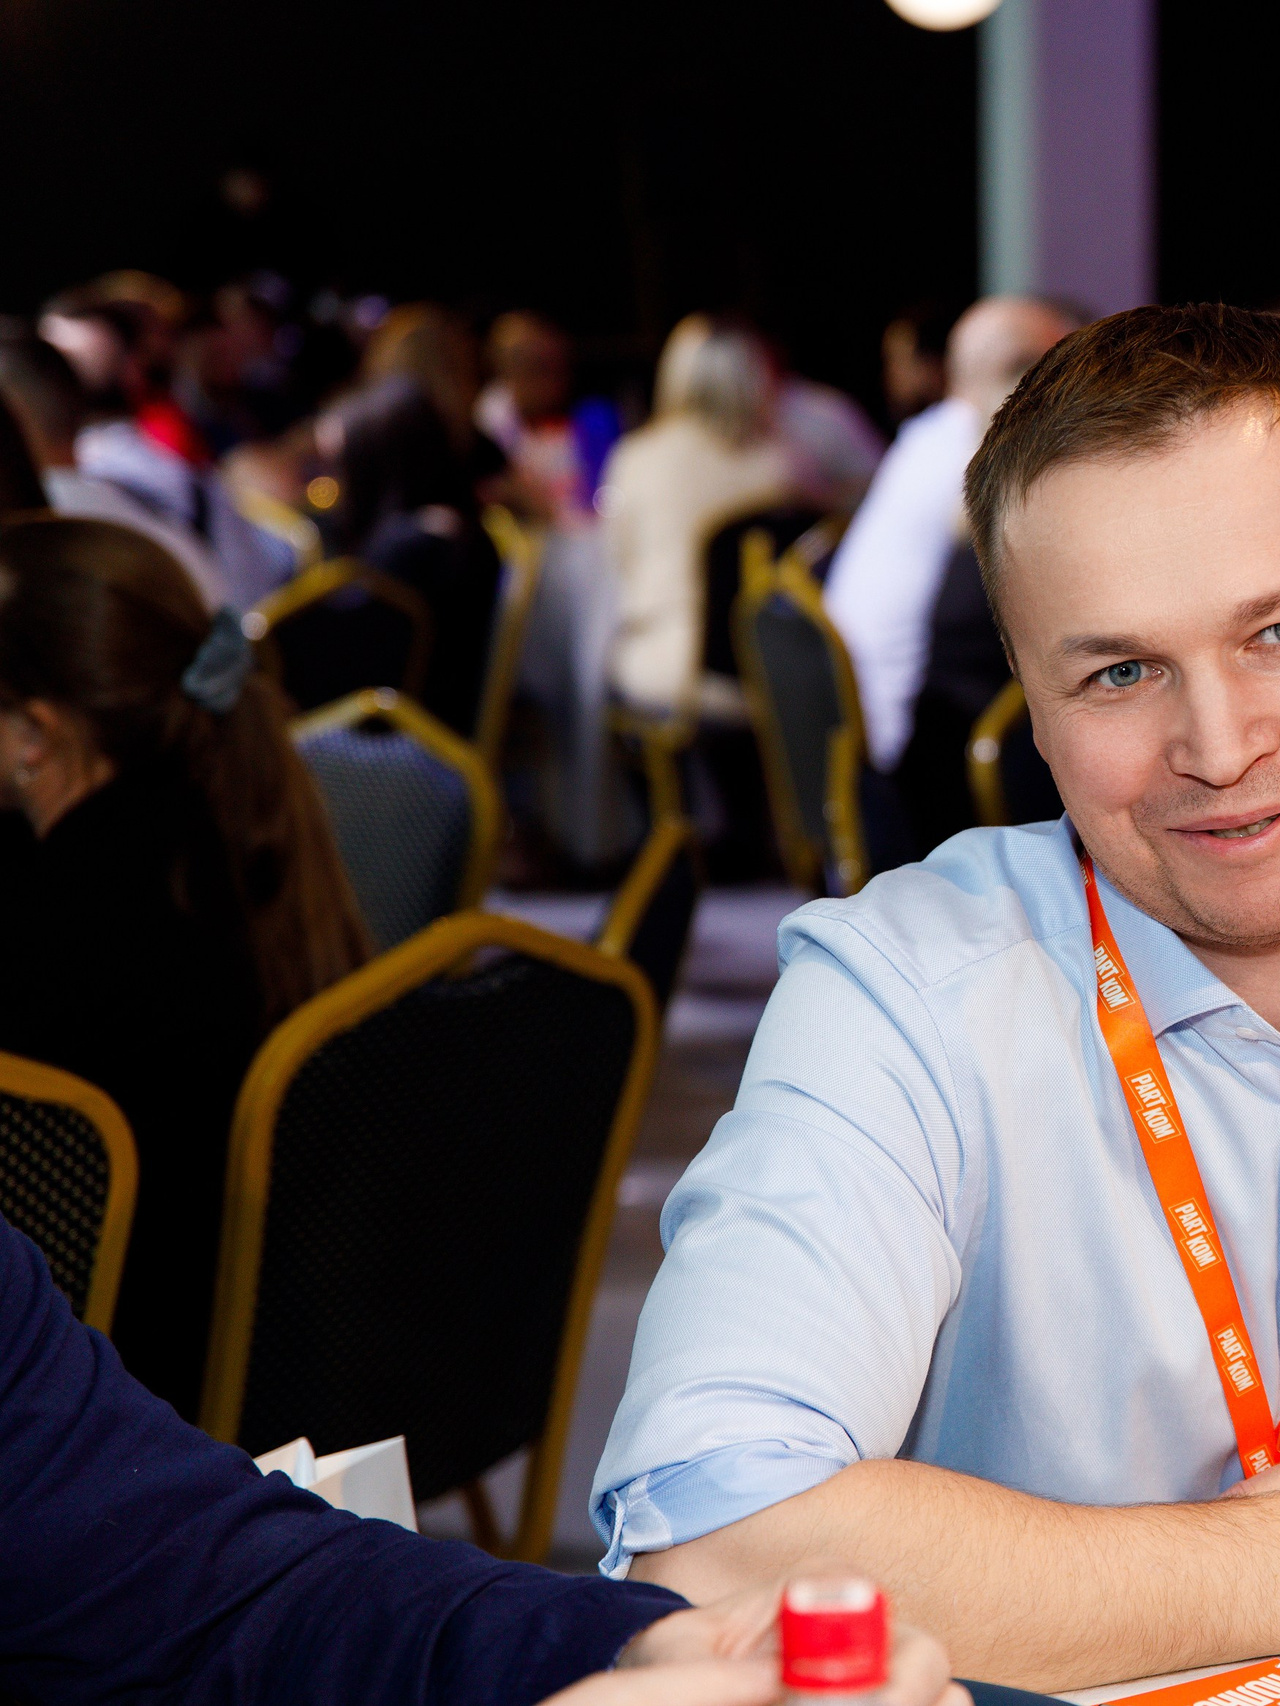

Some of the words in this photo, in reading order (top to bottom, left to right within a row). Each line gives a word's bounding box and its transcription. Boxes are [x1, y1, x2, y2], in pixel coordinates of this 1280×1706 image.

[1099, 976, 1129, 1008] KOM
[1130, 1073, 1166, 1108] PART
[1142, 1105, 1175, 1139] KOM
[1174, 1202, 1207, 1236] PART
[1186, 1233, 1216, 1267] KOM
[1217, 1328, 1247, 1360] PART
[1227, 1359, 1254, 1392] KOM
